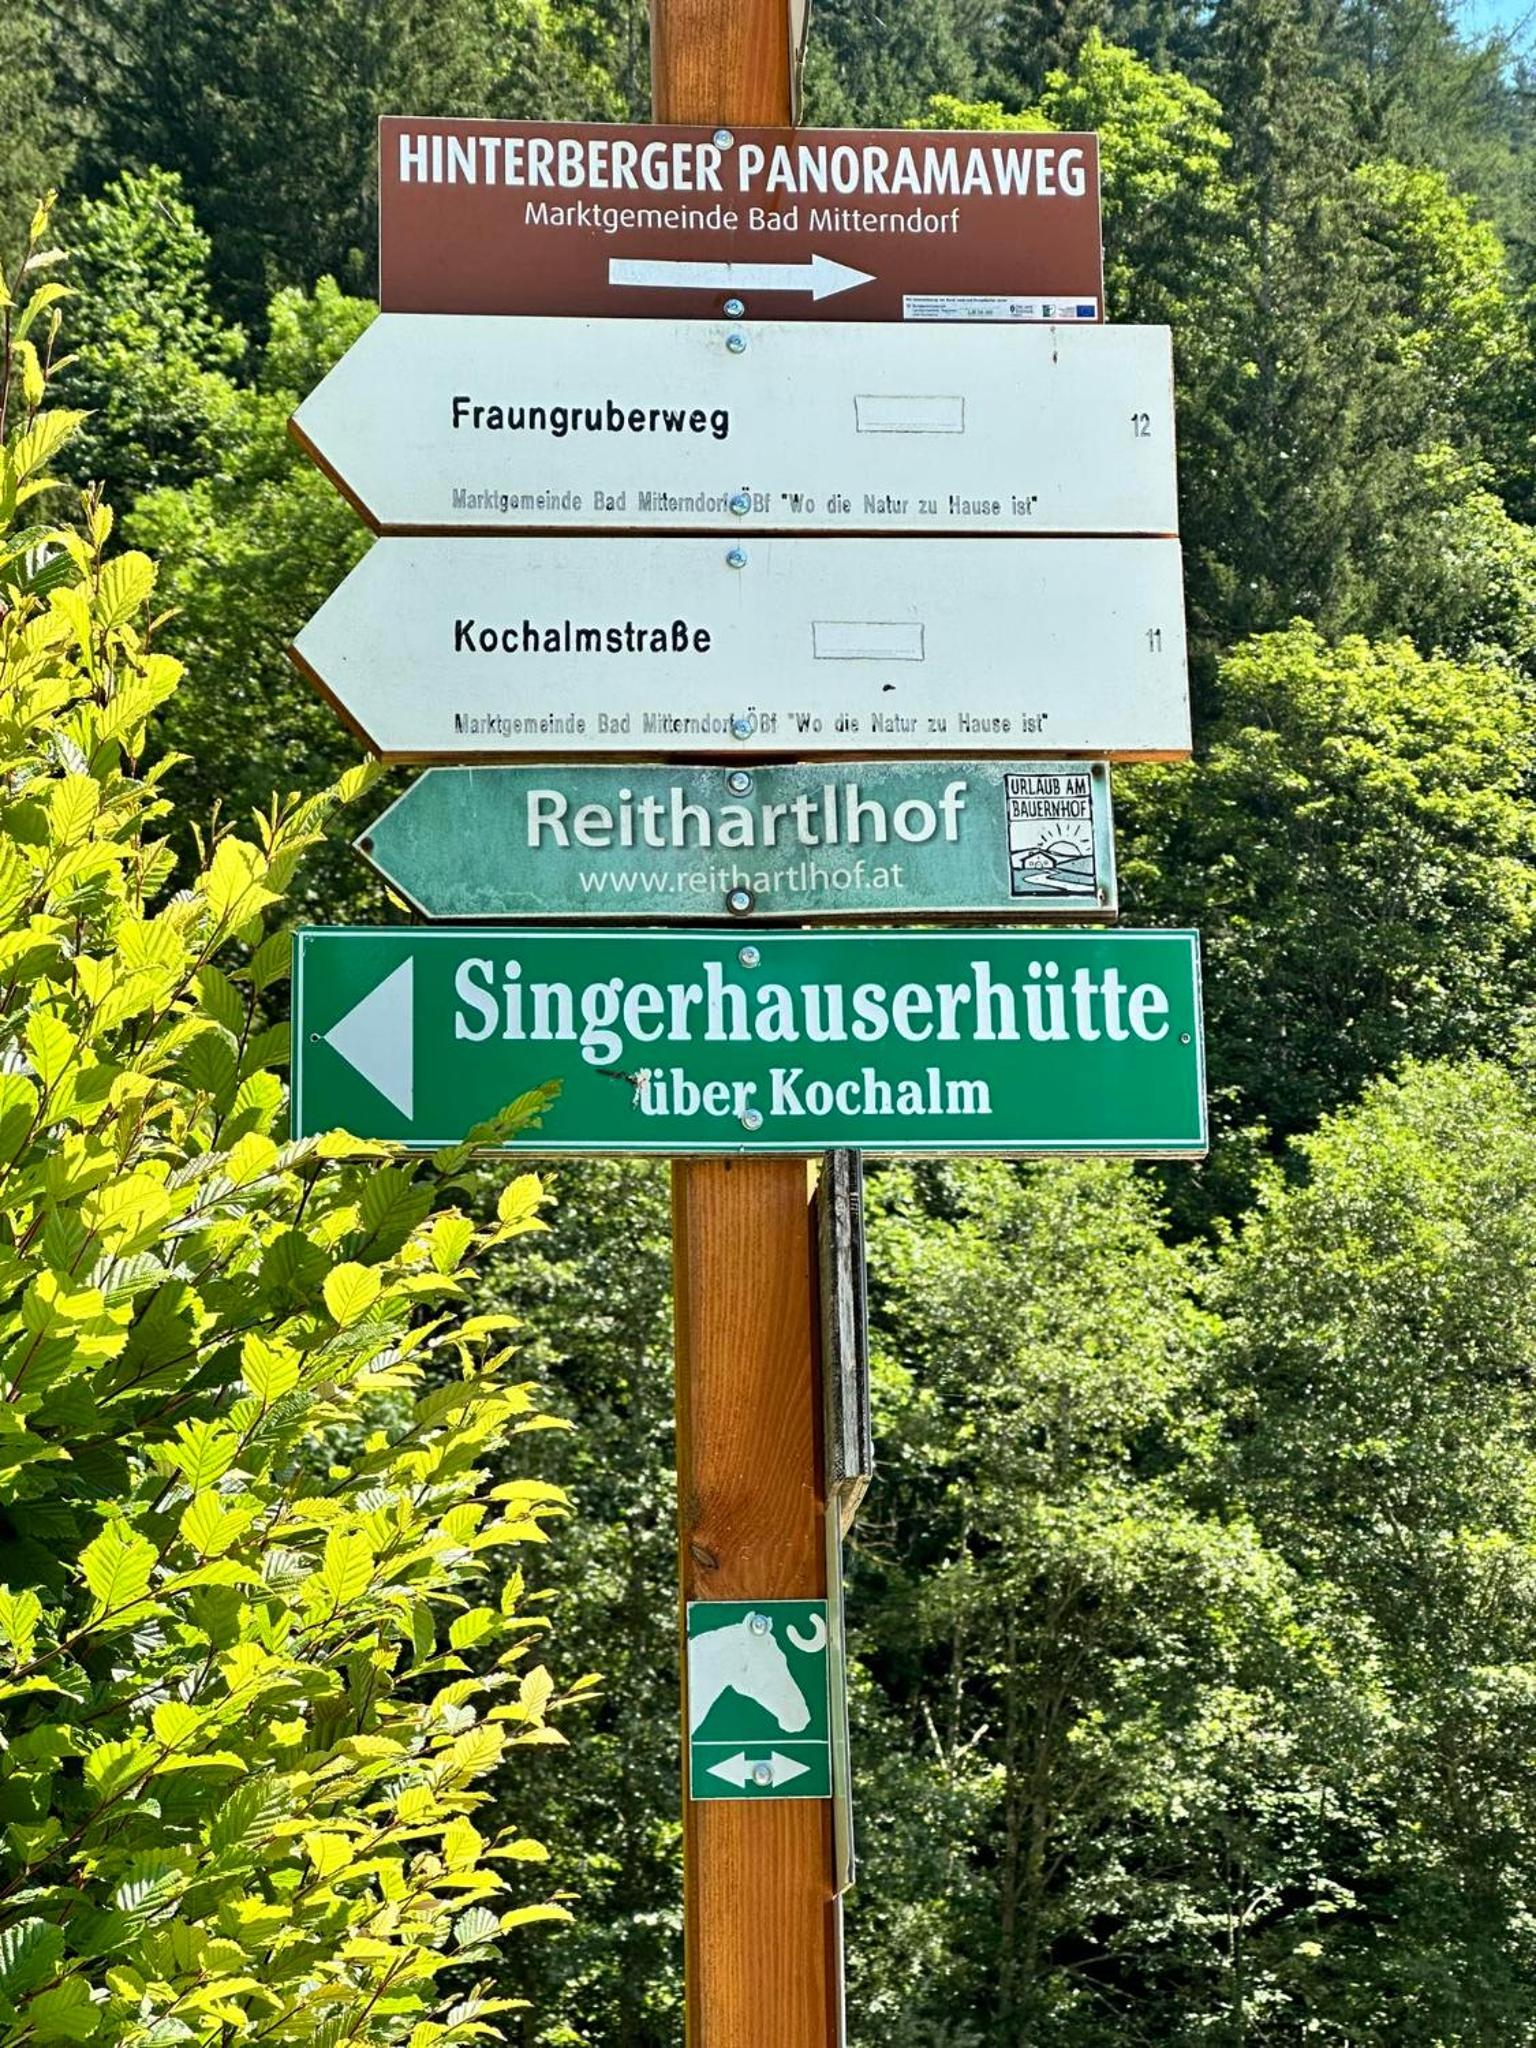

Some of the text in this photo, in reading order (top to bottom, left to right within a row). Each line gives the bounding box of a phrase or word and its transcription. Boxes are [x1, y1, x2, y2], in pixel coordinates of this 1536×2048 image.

[399, 134, 1086, 197] HINTERBERGER PANORAMAWEG
[524, 201, 960, 233] Marktgemeinde Bad Mitterndorf
[452, 396, 729, 439] Fraungruberweg
[1131, 412, 1151, 438] 12
[452, 488, 582, 513] Marktgemeinde
[594, 491, 626, 511] Bad
[638, 490, 728, 513] Mitterndorf
[827, 494, 851, 514] die
[864, 494, 908, 515] Natur
[918, 498, 938, 515] zu
[949, 495, 1001, 516] Hause
[454, 619, 711, 653] Kochalmstraße
[1145, 628, 1163, 652] 11
[454, 713, 586, 736] Marktgemeinde
[598, 714, 631, 733] Bad
[643, 712, 734, 734] Mitterndorf
[834, 713, 859, 733] die
[872, 713, 918, 734] Natur
[927, 717, 947, 734] zu
[959, 714, 1011, 734] Hause
[1011, 778, 1086, 796] URLAUB AM
[526, 781, 966, 849] Reithartlhof
[1012, 799, 1087, 818] BAUERNHOF
[579, 860, 904, 893] www.reithartlhof.at
[453, 958, 1170, 1066] Singerhauserhütte
[639, 1067, 993, 1116] über Kochalm
